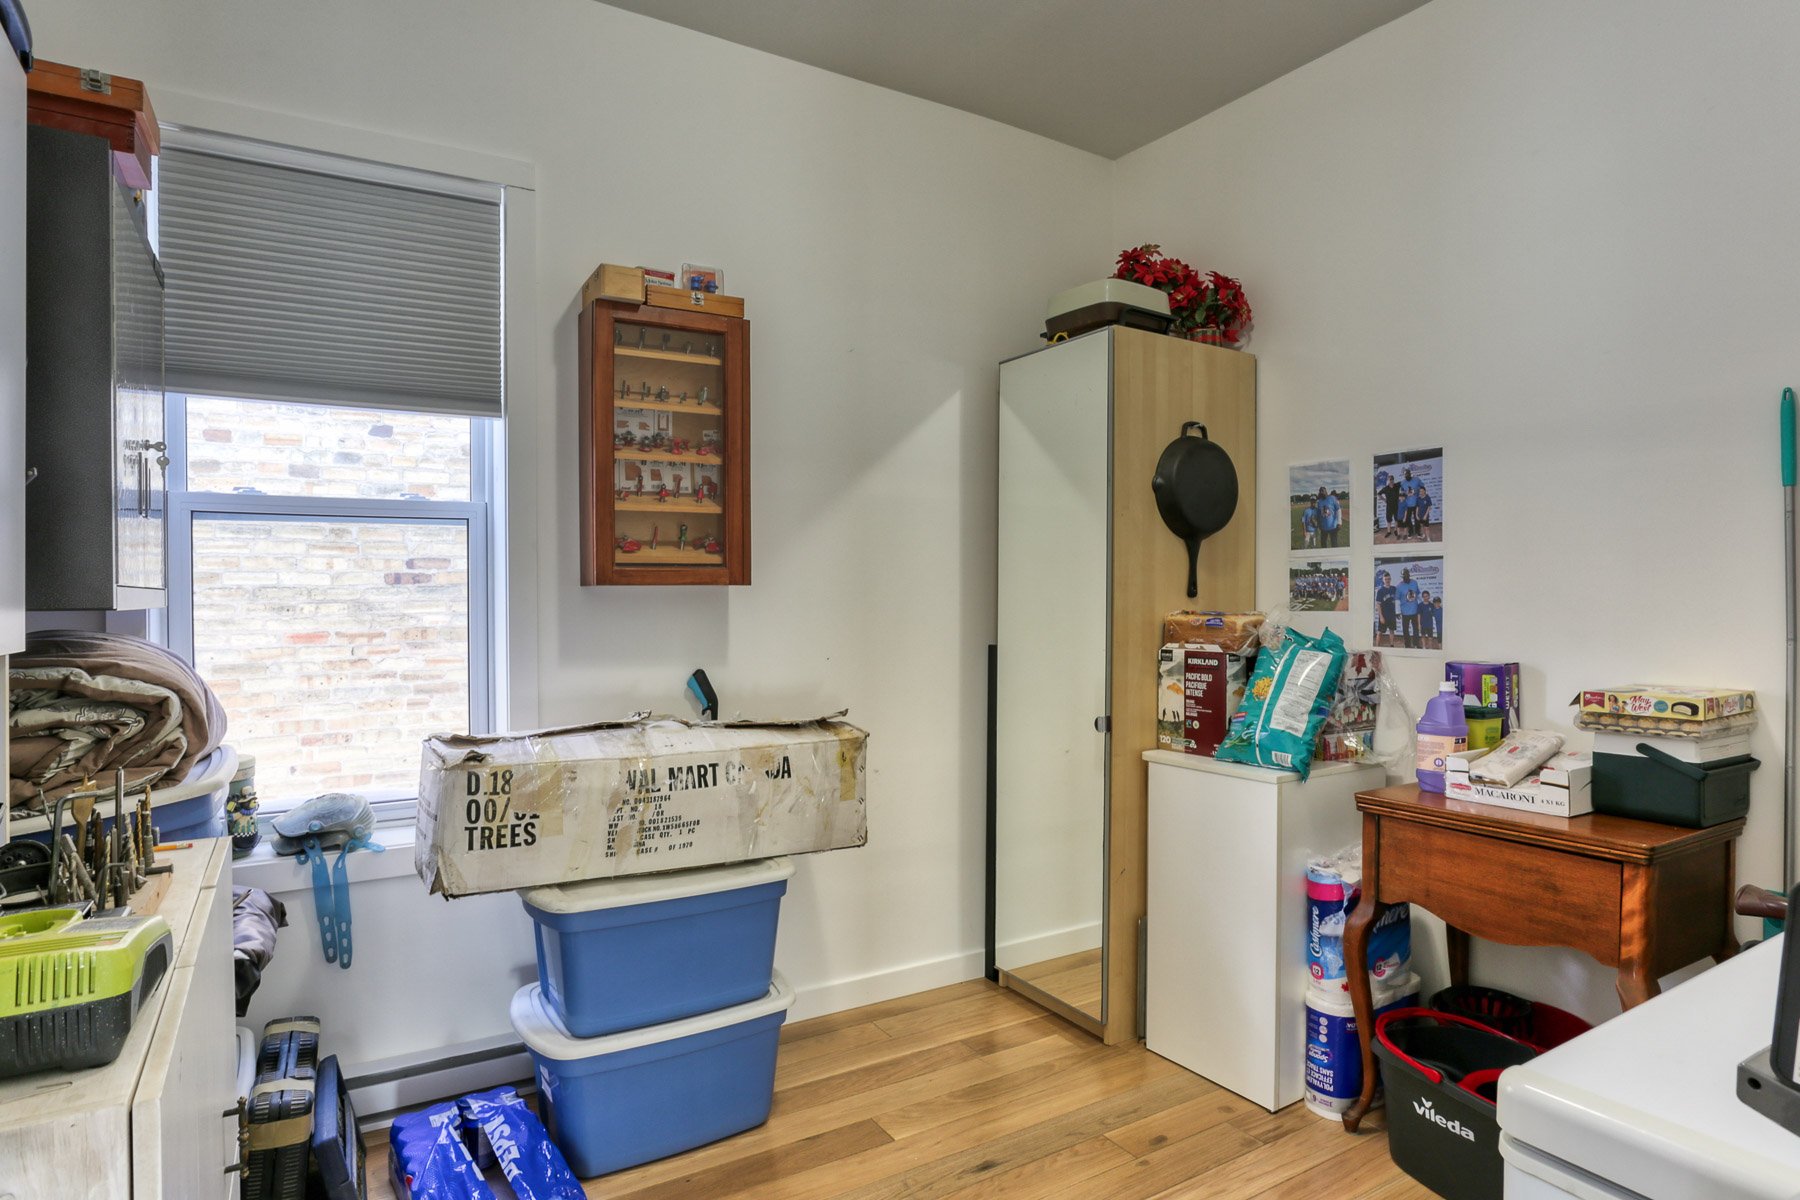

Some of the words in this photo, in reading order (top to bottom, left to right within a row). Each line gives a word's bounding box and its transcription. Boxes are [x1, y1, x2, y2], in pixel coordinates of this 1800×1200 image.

[1187, 658, 1218, 666] KIRKLAND
[1185, 672, 1201, 681] PACIFIC
[1201, 673, 1213, 682] BOLD
[1185, 689, 1204, 698] INTENSE
[1160, 735, 1171, 744] 120
[668, 763, 719, 792] MART
[1475, 787, 1535, 804] MACARONI
[464, 822, 537, 851] TREES
[1310, 905, 1323, 957] Cashmere
[1412, 1096, 1475, 1142] vileda
[483, 1113, 524, 1183] PEPSI
